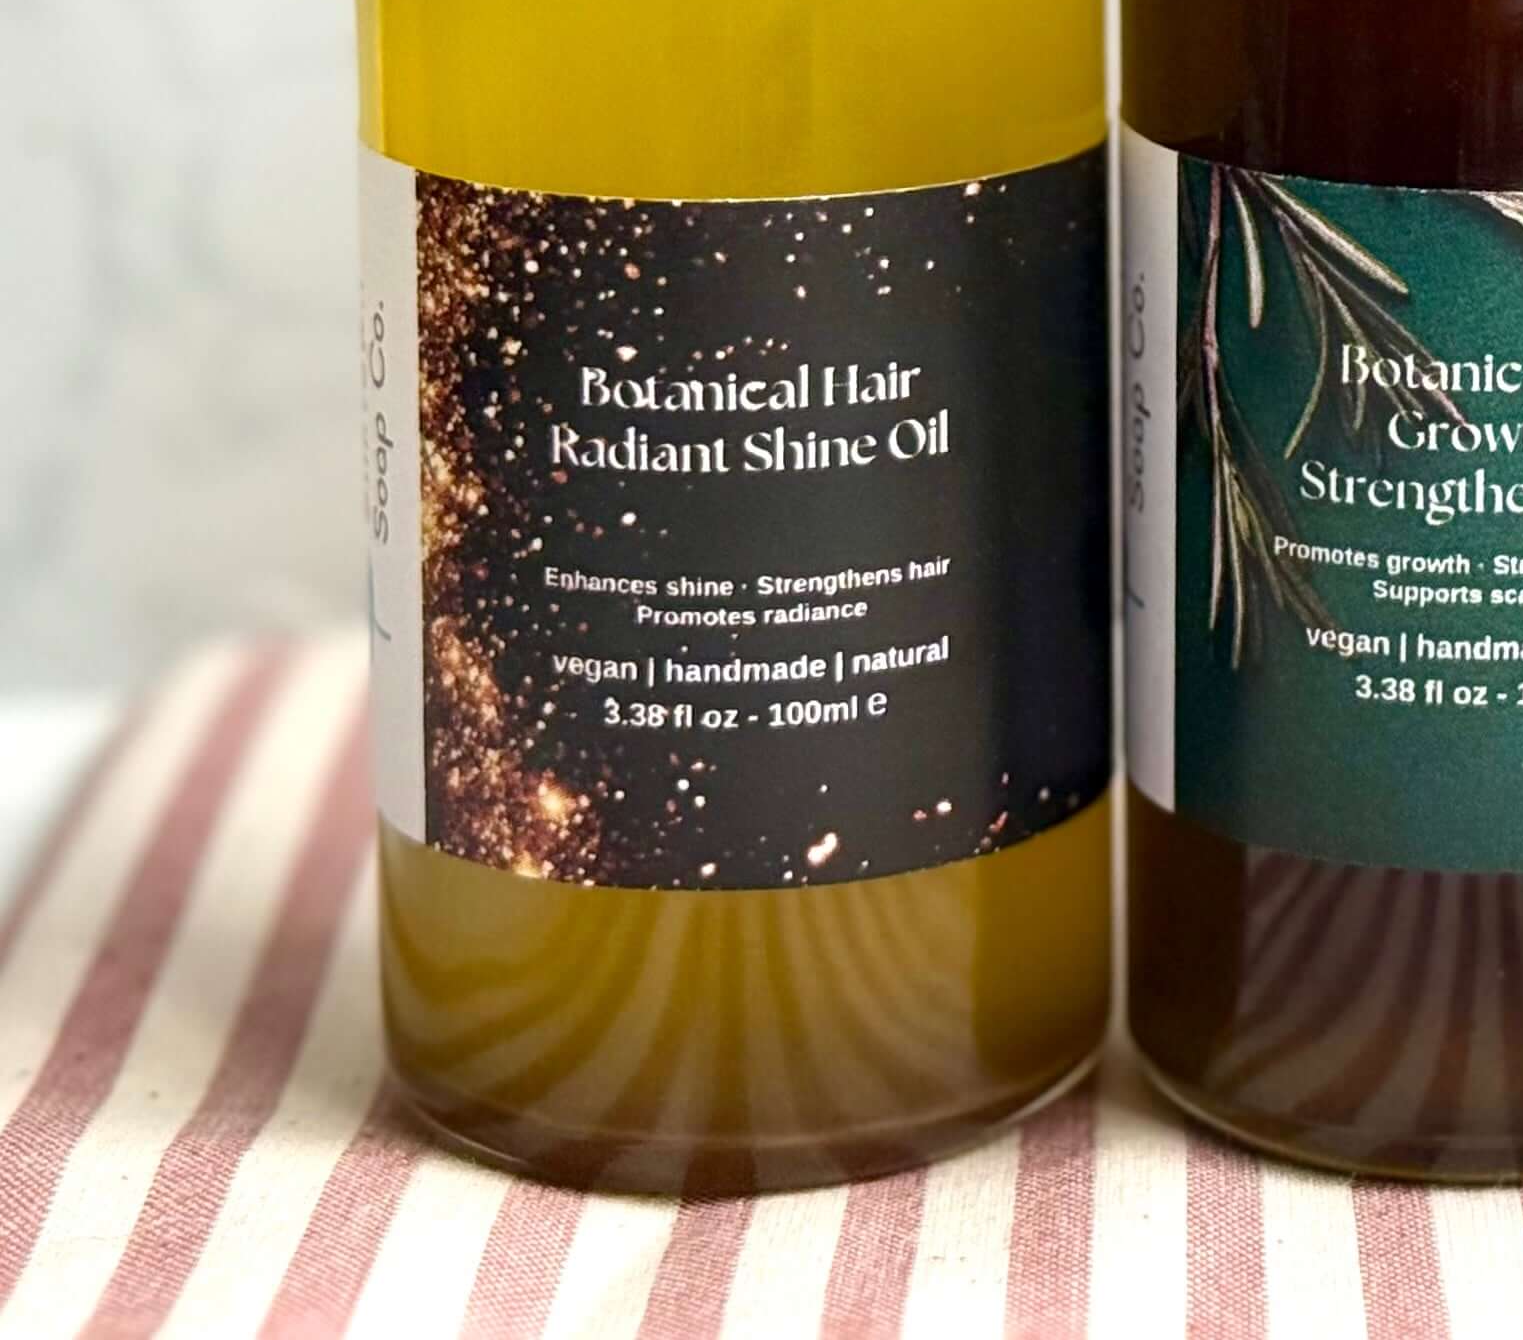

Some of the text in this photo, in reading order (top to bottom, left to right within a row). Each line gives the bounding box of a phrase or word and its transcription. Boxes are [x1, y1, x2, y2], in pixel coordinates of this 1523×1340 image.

[369, 300, 385, 390] Co.
[581, 362, 921, 412] Botanical Hair
[551, 408, 949, 473] Radiant Shine Oil
[373, 411, 395, 546] Soap
[1273, 535, 1379, 569] Promotes
[1387, 554, 1470, 576] growth
[544, 556, 951, 597] Enhances shine Strengthens hair
[1373, 579, 1482, 607] Supports
[636, 599, 868, 627] Promotes radiance
[553, 655, 637, 684] vegan
[666, 654, 826, 684] handmade
[852, 635, 949, 675] natural
[1306, 626, 1390, 657] vegan
[1354, 674, 1415, 703] 3.38
[1424, 680, 1442, 705] fl
[1453, 684, 1488, 706] oz
[604, 698, 665, 726] 3.38
[674, 704, 692, 727] fl
[701, 708, 738, 728] oz
[768, 696, 857, 727] 100ml
